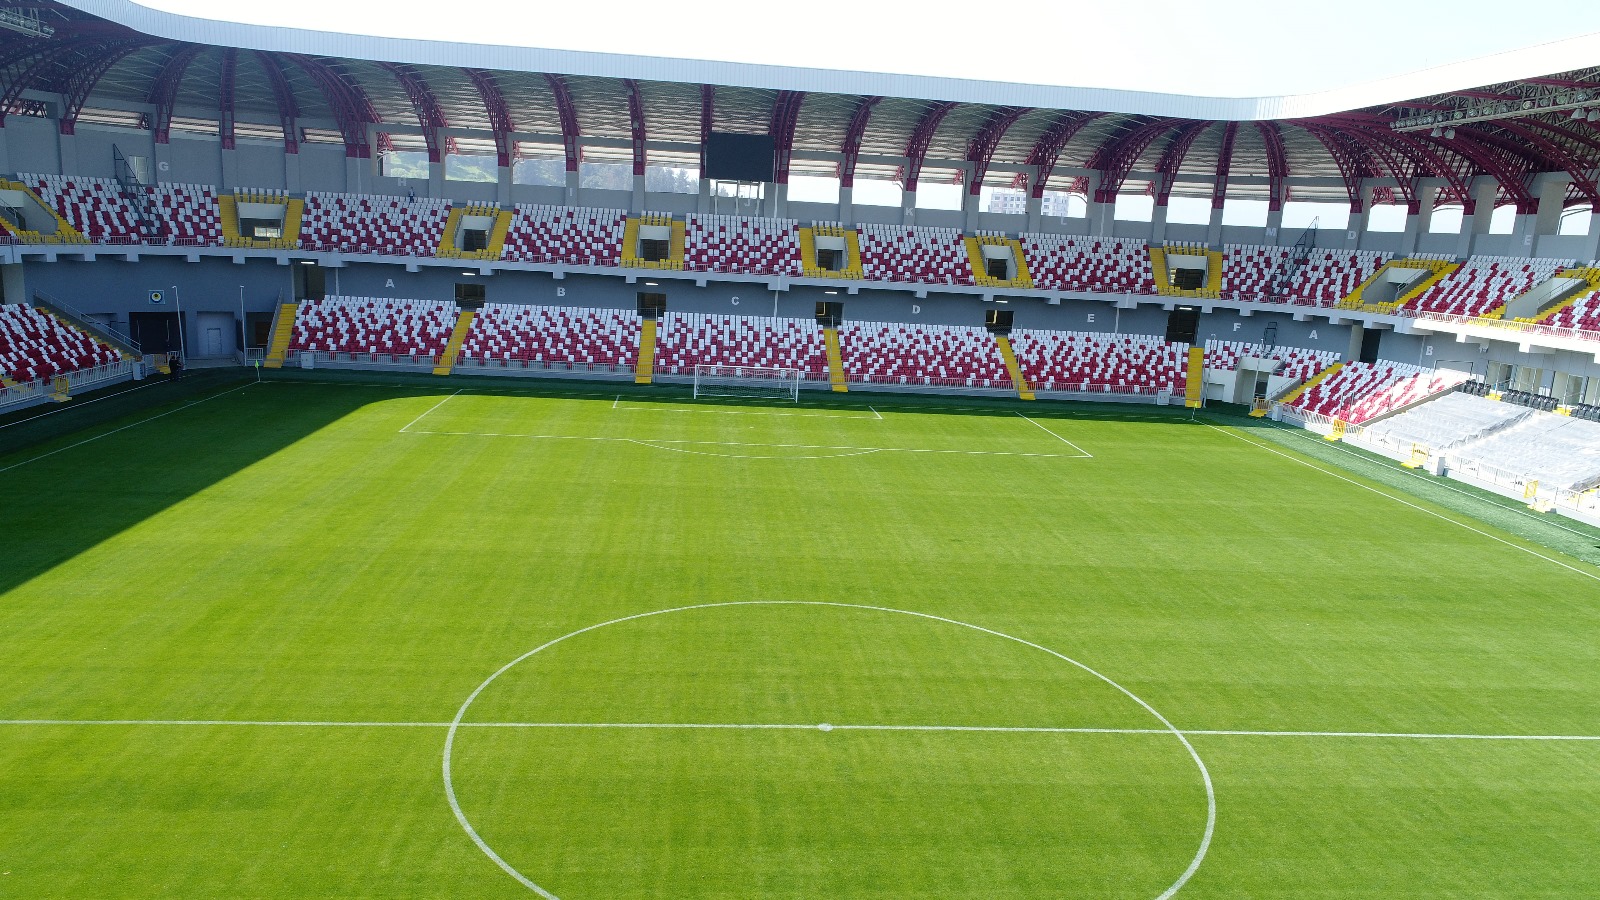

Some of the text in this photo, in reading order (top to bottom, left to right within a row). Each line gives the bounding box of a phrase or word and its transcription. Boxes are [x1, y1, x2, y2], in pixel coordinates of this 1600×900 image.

[159, 162, 168, 171] G
[398, 178, 406, 186] H
[906, 208, 913, 216] K
[1266, 228, 1276, 236] M
[1348, 231, 1356, 239] D
[1524, 235, 1531, 245] E
[385, 279, 395, 288] A
[557, 287, 565, 296] B
[732, 297, 739, 305] C
[912, 305, 920, 314] D
[1087, 314, 1094, 322] E
[1233, 323, 1241, 331] F
[1309, 330, 1318, 339] A
[1426, 346, 1433, 355] B
